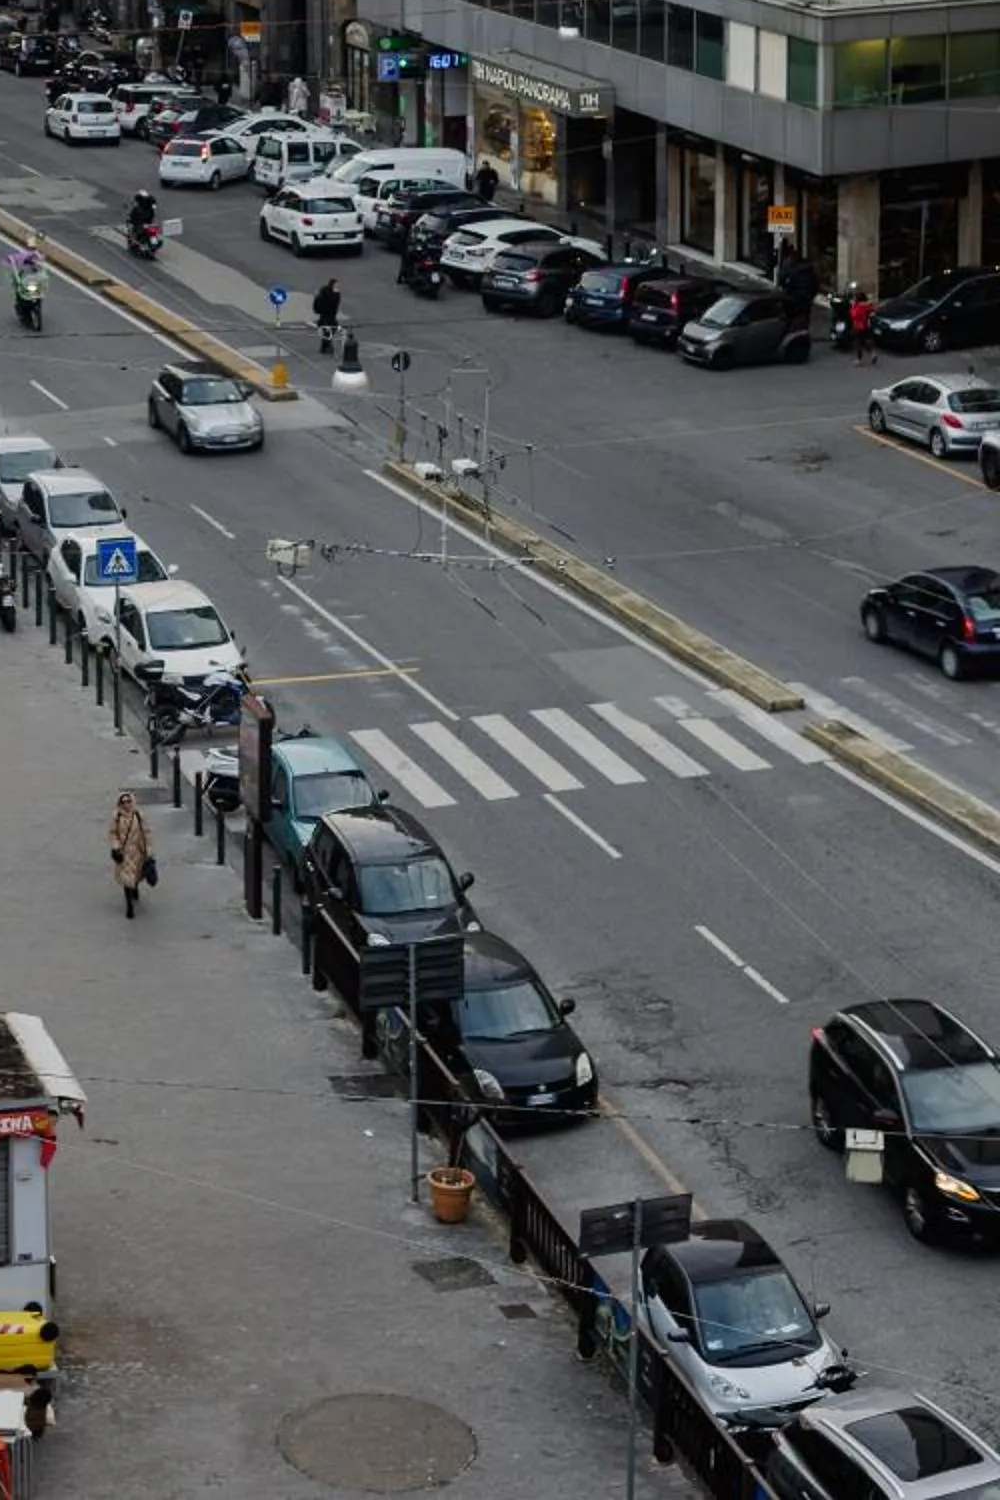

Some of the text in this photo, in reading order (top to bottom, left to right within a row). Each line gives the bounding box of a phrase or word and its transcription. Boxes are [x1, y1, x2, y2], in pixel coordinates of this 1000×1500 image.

[384, 59, 395, 76] P
[485, 65, 517, 91] NAPOLI
[519, 75, 571, 111] PANORAMA
[770, 210, 793, 220] TAXI
